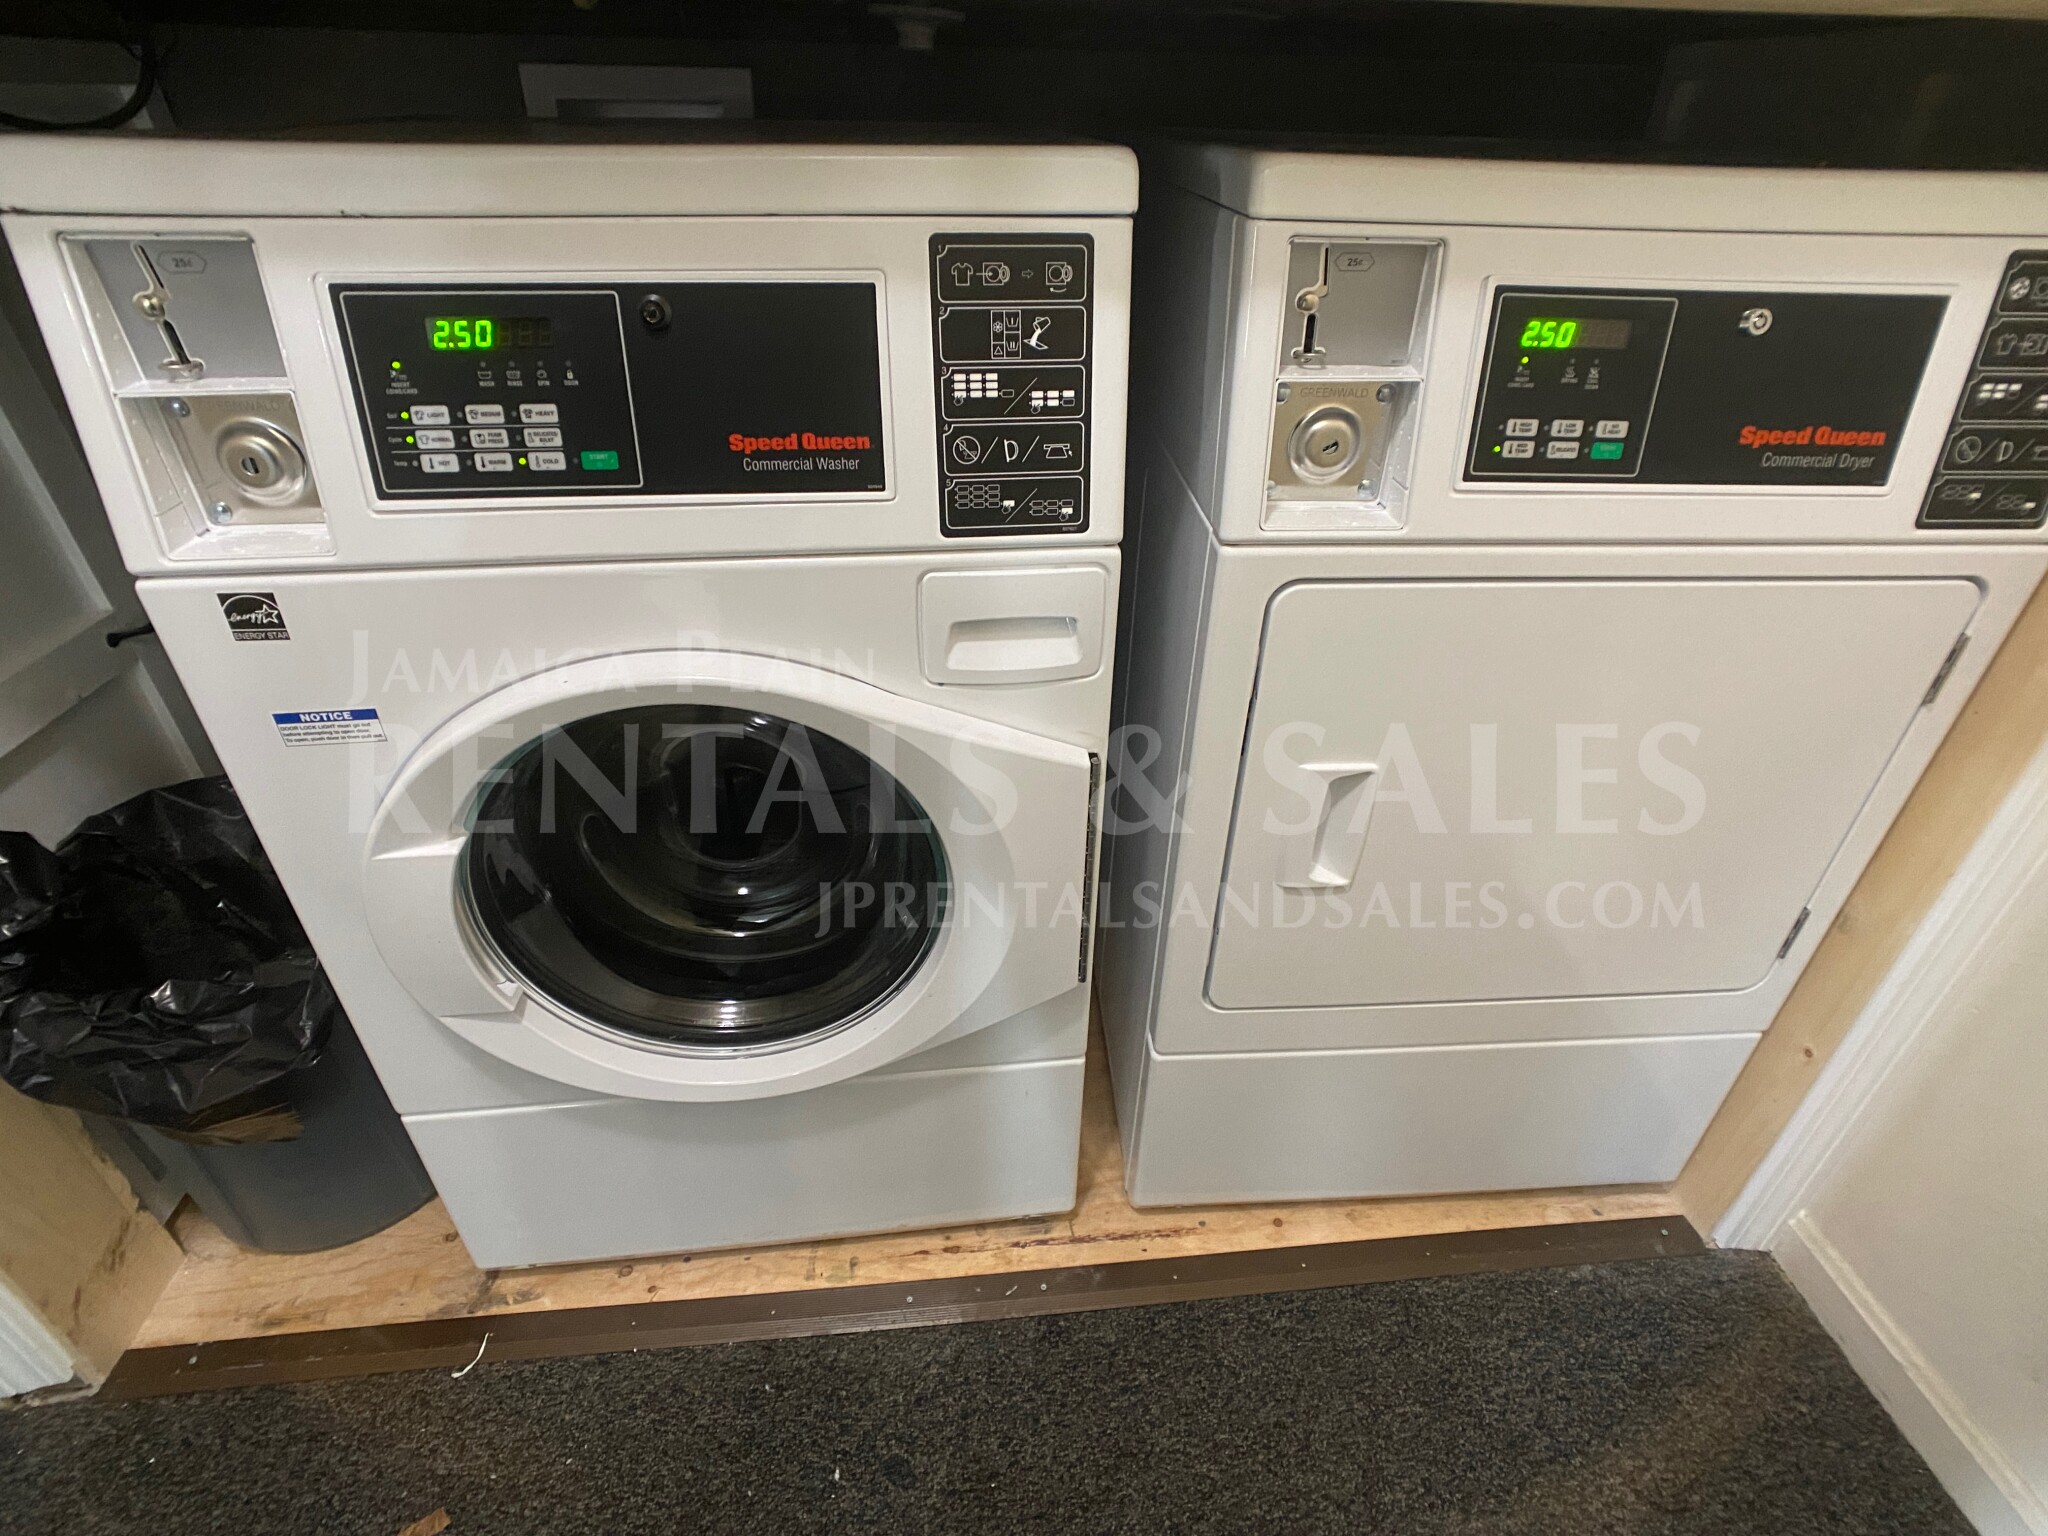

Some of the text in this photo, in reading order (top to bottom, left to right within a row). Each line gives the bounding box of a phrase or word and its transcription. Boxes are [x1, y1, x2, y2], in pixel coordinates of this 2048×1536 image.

[433, 320, 492, 348] 2.50
[1521, 321, 1577, 348] 2.50
[1301, 387, 1369, 399] GREENWALD
[729, 432, 871, 454] Speed Queen
[1739, 425, 1887, 449] Speed Queen
[743, 456, 860, 472] Commercial Washer
[1761, 452, 1876, 471] Commercial Dryer
[233, 631, 288, 640] ENERGY STAR
[299, 711, 353, 722] NOTICE
